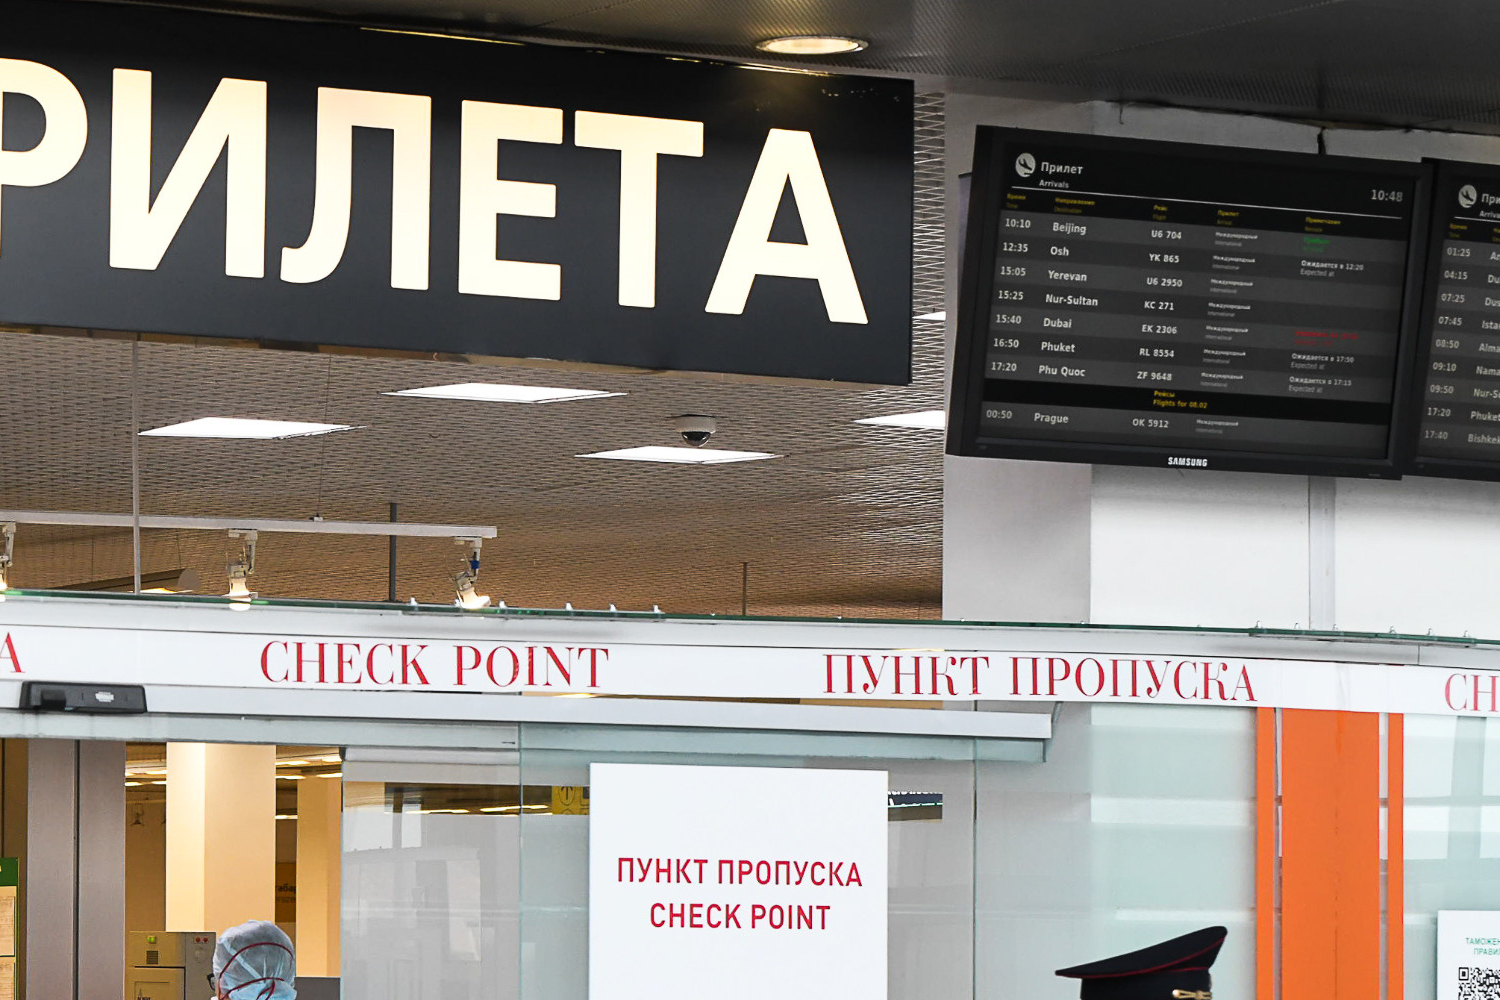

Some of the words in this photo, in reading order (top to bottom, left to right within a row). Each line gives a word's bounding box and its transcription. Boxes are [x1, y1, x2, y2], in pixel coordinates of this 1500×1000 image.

[1041, 162, 1083, 175] Прилет
[1039, 179, 1069, 189] Arrivals
[1371, 189, 1403, 202] 10:48
[1005, 218, 1031, 229] 10:10
[1052, 222, 1087, 236] Beijing
[1151, 230, 1163, 239] U6
[1165, 231, 1182, 240] 704
[1003, 242, 1028, 253] 12:35
[1050, 246, 1069, 256] Osh
[1149, 253, 1161, 262] YK
[1163, 254, 1180, 263] 865
[1446, 247, 1471, 258] 01:25
[1000, 266, 1026, 276] 15:05
[1048, 270, 1088, 281] Yerevan
[1146, 277, 1159, 286] U6
[1160, 278, 1183, 287] 2950
[1443, 270, 1468, 280] 04:15
[998, 290, 1024, 300] 15:25
[1045, 294, 1099, 306] Nur-Sultan
[1144, 301, 1156, 309] KC
[1158, 301, 1175, 311] 271
[1440, 293, 1466, 304] 07:25
[995, 314, 1022, 324] 15:40
[1043, 317, 1073, 329] Dubai
[1141, 324, 1154, 333] EK
[1155, 325, 1178, 335] 2306
[1438, 316, 1463, 326] 07:45
[993, 338, 1020, 348] 16:50
[1041, 341, 1076, 353] Phuket
[1139, 348, 1151, 357] RL
[1153, 349, 1175, 358] 8554
[1435, 339, 1460, 350] 08:50
[991, 362, 1017, 372] 17:20
[1038, 365, 1058, 375] Phu
[1060, 366, 1086, 378] Quoc
[1136, 371, 1148, 380] ZF
[1150, 372, 1173, 381] 9648
[1432, 361, 1457, 372] 09:10
[1429, 384, 1455, 395] 09:50
[986, 409, 1013, 419] 00:50
[1034, 412, 1069, 425] Prague
[1132, 418, 1145, 427] OK
[1147, 419, 1169, 429] 5912
[1427, 407, 1451, 417] 17:20
[1424, 430, 1449, 440] 17:40
[1167, 456, 1208, 467] SAMSUNG
[260, 640, 431, 685] CHECK
[453, 645, 609, 689] POINT
[823, 654, 990, 696] ПУНКТ
[1009, 656, 1258, 703] ПРОПУСКА
[1444, 673, 1500, 713] CH
[617, 857, 709, 885] ПУНКТ
[718, 859, 863, 887] ПРОПУСКА
[650, 902, 742, 929] CHECK
[751, 904, 831, 930] POINT
